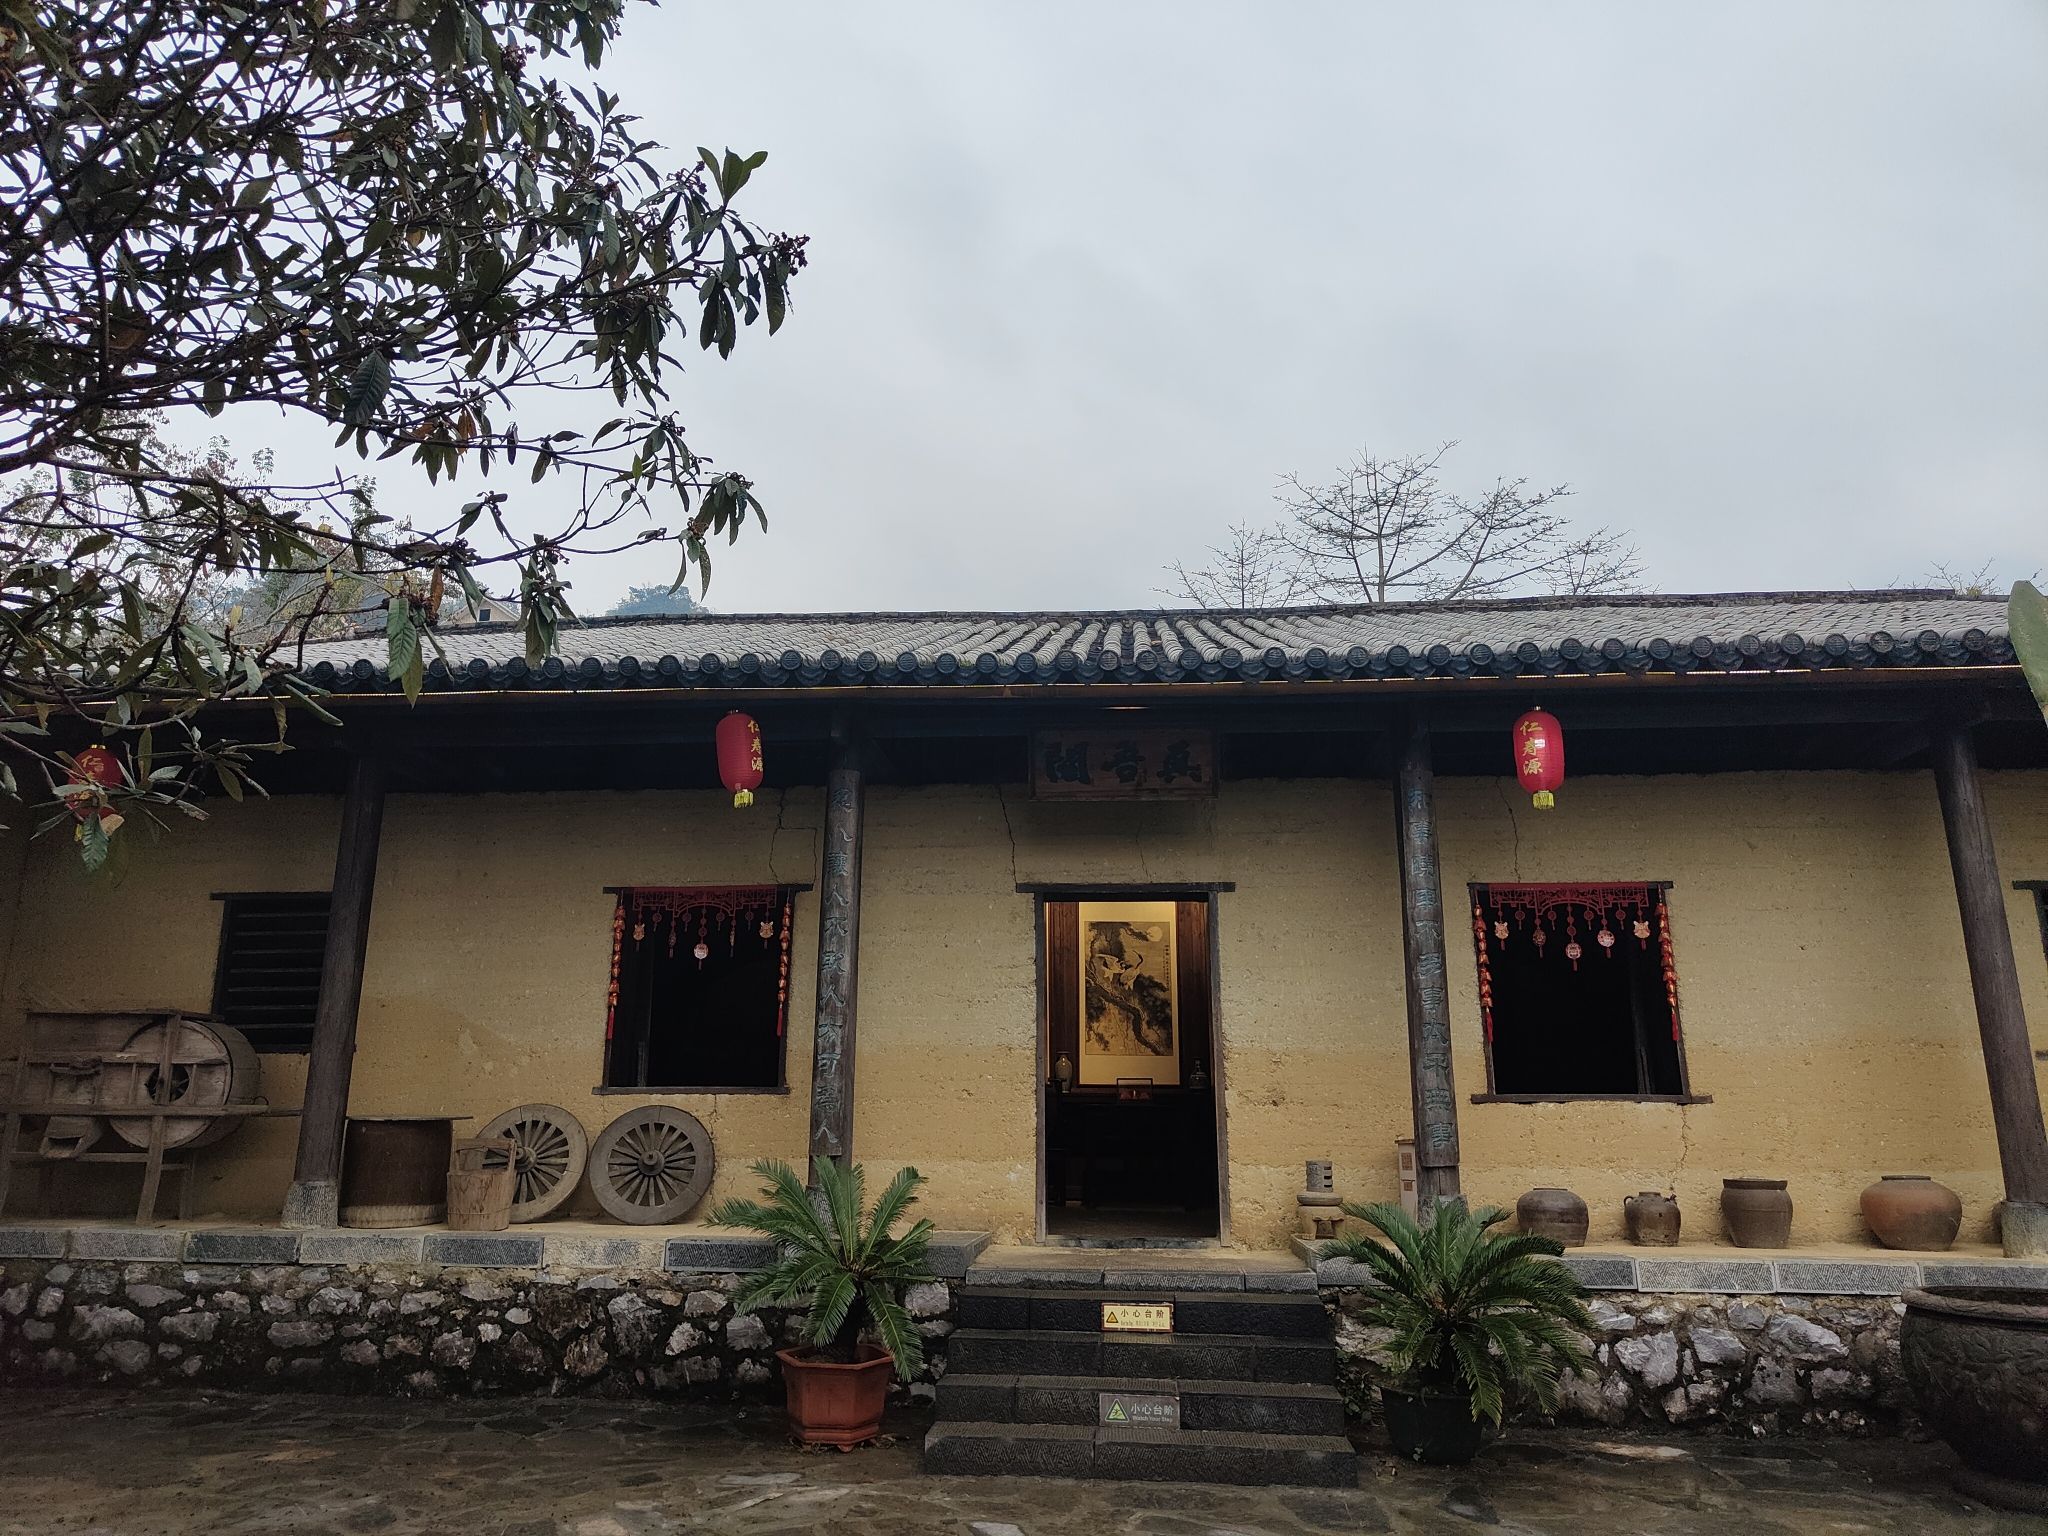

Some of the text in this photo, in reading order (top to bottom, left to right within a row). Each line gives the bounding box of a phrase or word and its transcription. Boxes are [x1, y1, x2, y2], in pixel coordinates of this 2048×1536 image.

[747, 719, 764, 772] 仁寿源
[1120, 1308, 1165, 1319] 小心台阶
[1130, 1402, 1175, 1416] 小心台阶
